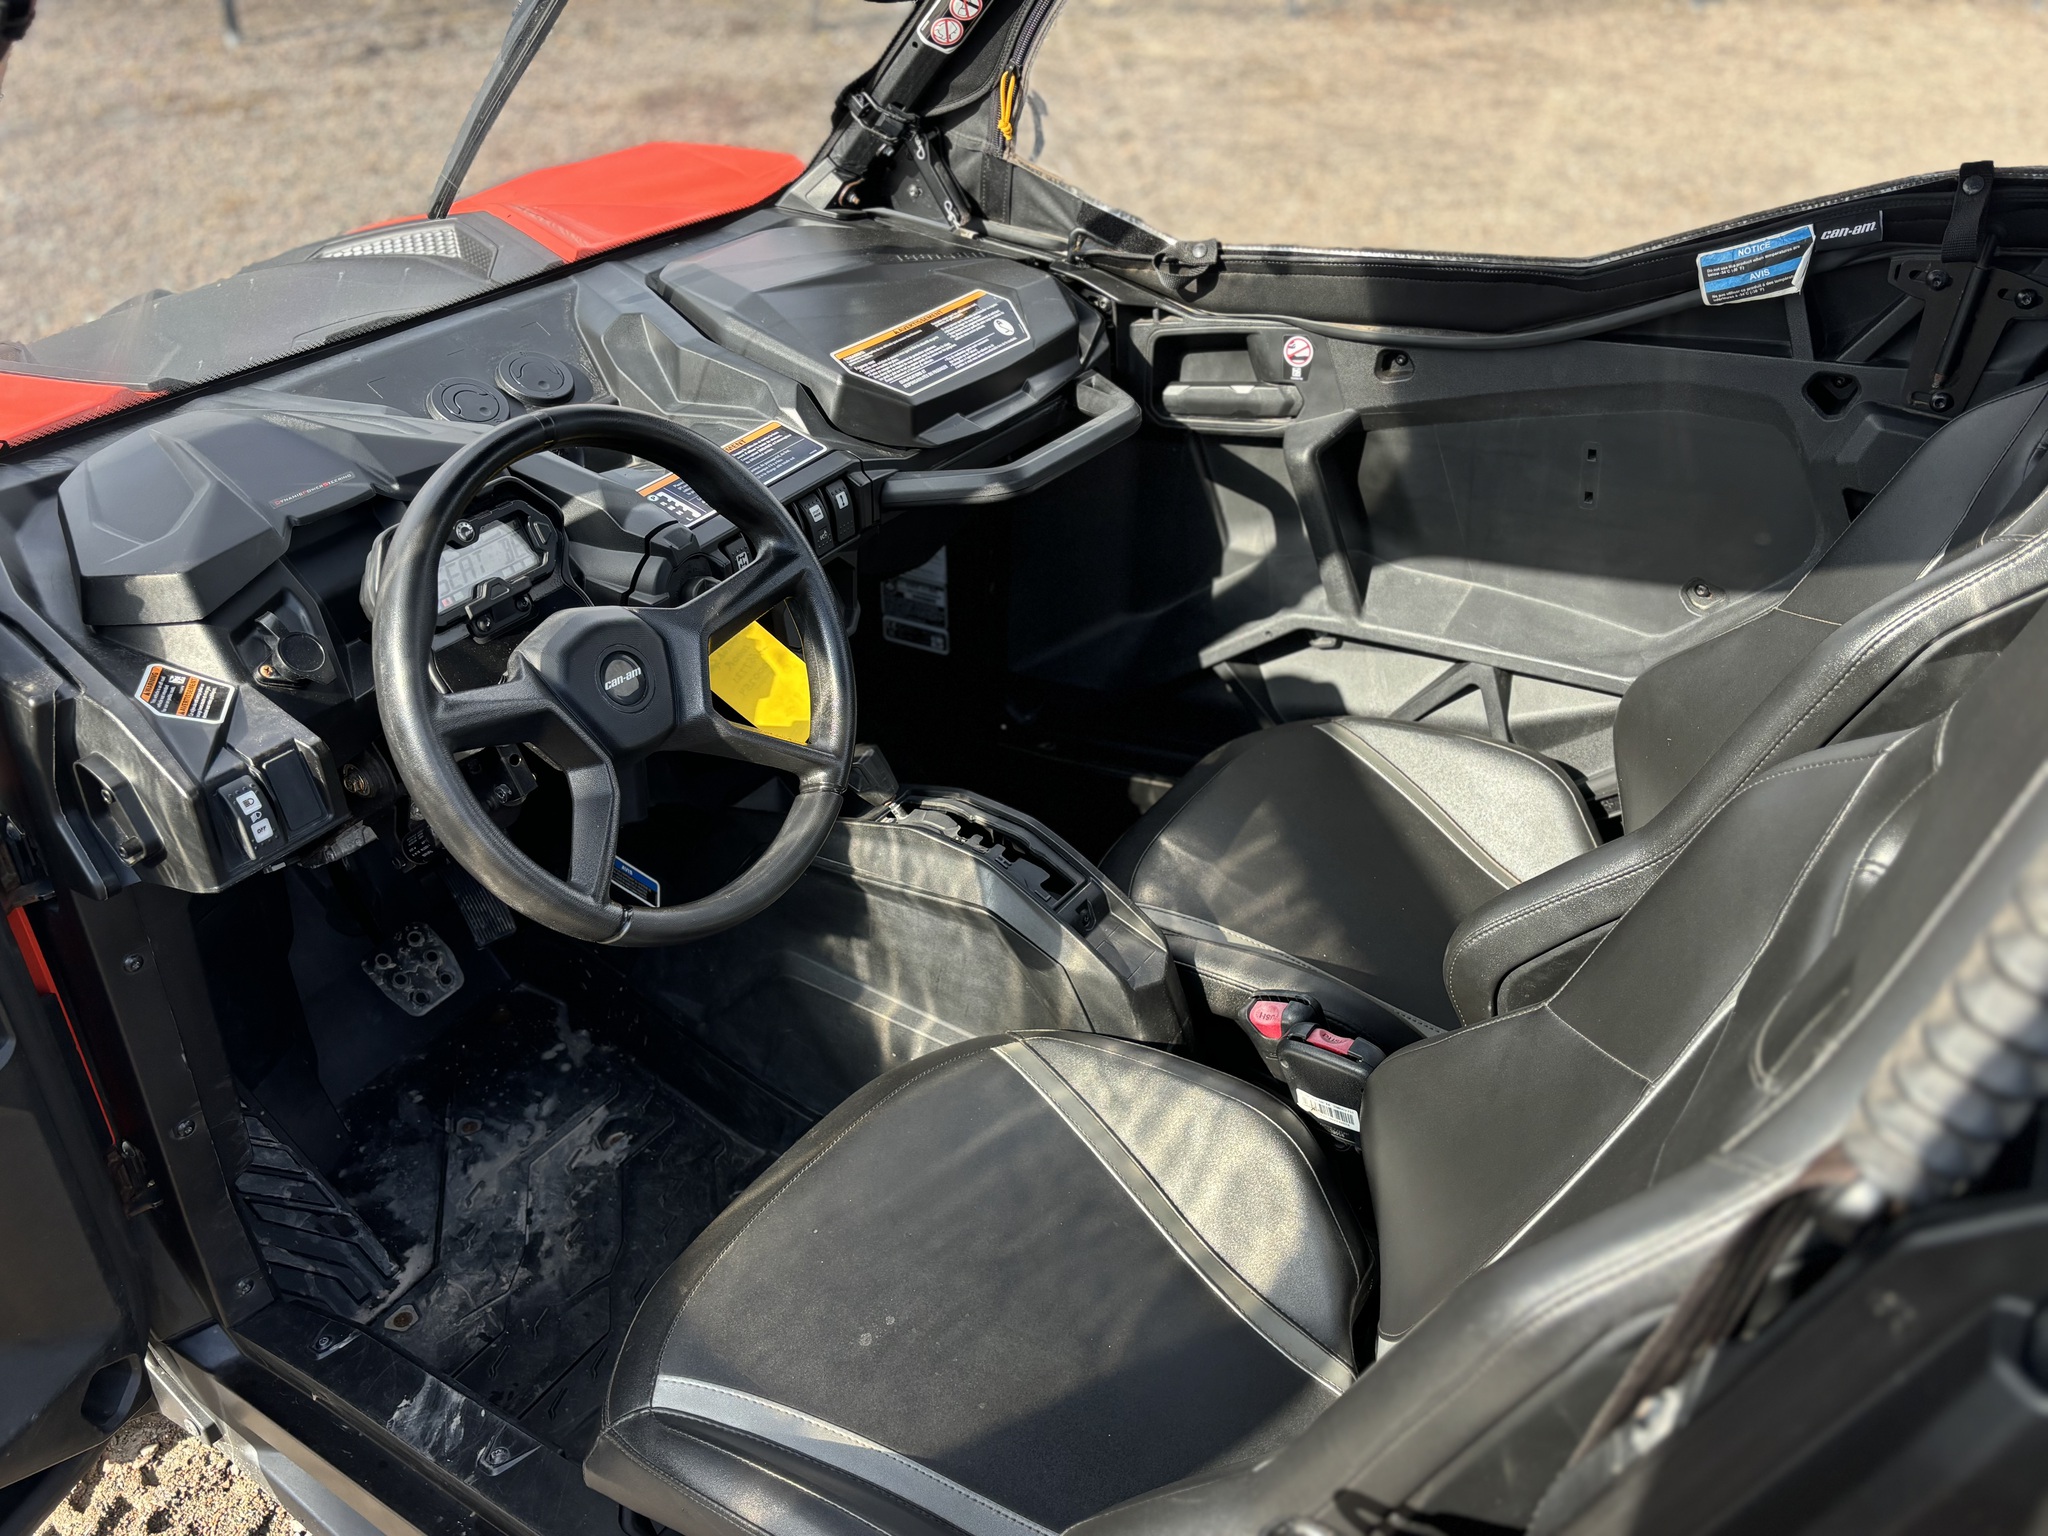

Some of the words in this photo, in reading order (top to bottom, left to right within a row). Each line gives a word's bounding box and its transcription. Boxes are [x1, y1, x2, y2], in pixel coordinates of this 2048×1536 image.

[1821, 222, 1876, 240] can-am
[1738, 240, 1771, 257] NOTICE
[1750, 268, 1770, 281] AVIS
[900, 310, 942, 332] AVERTISSEMENT
[147, 672, 159, 689] WARNING
[605, 667, 642, 690] can-am
[180, 678, 197, 710] AVERTISSEMENT
